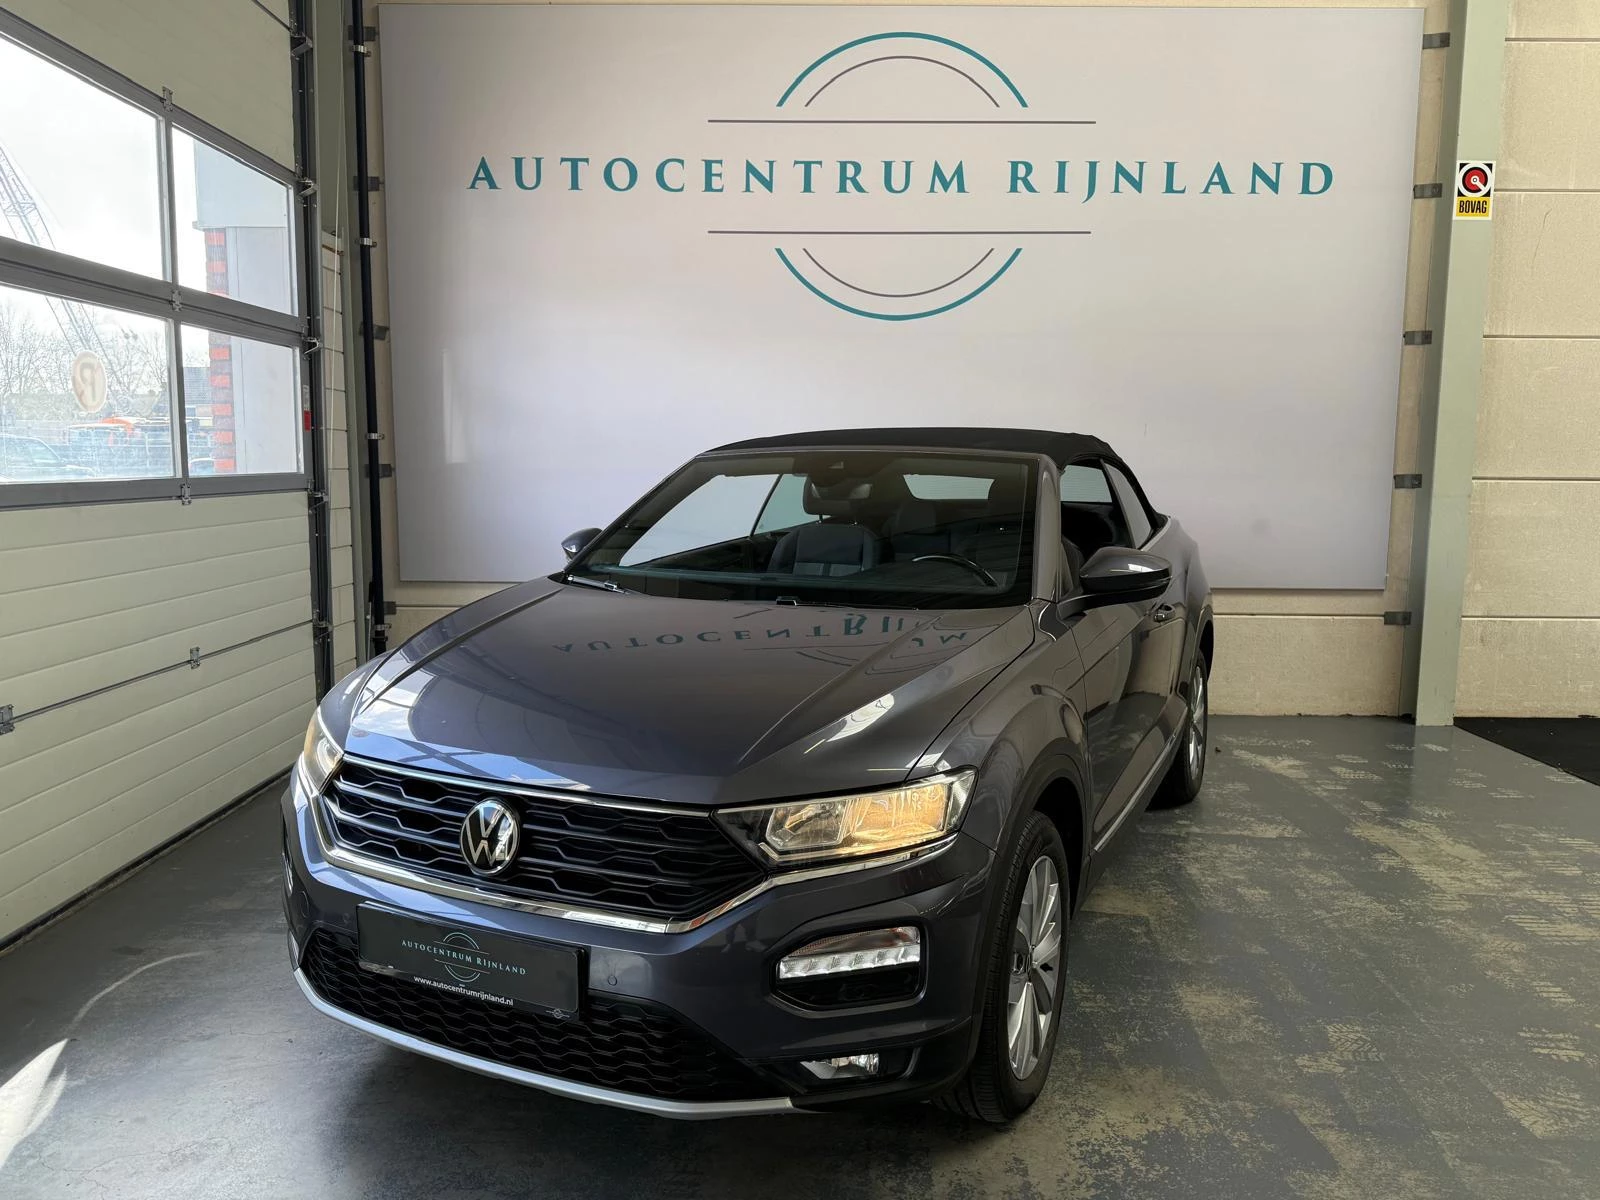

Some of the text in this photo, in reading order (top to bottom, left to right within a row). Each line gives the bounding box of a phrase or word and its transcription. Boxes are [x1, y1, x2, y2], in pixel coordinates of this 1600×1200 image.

[467, 156, 1336, 204] AUTOCENTRUM RIJNLAND
[1458, 199, 1488, 214] BOVAG
[401, 940, 527, 976] AUTOCENTRUM RIJNLAND
[413, 975, 514, 1006] www.autocentrumrijnland.nl
